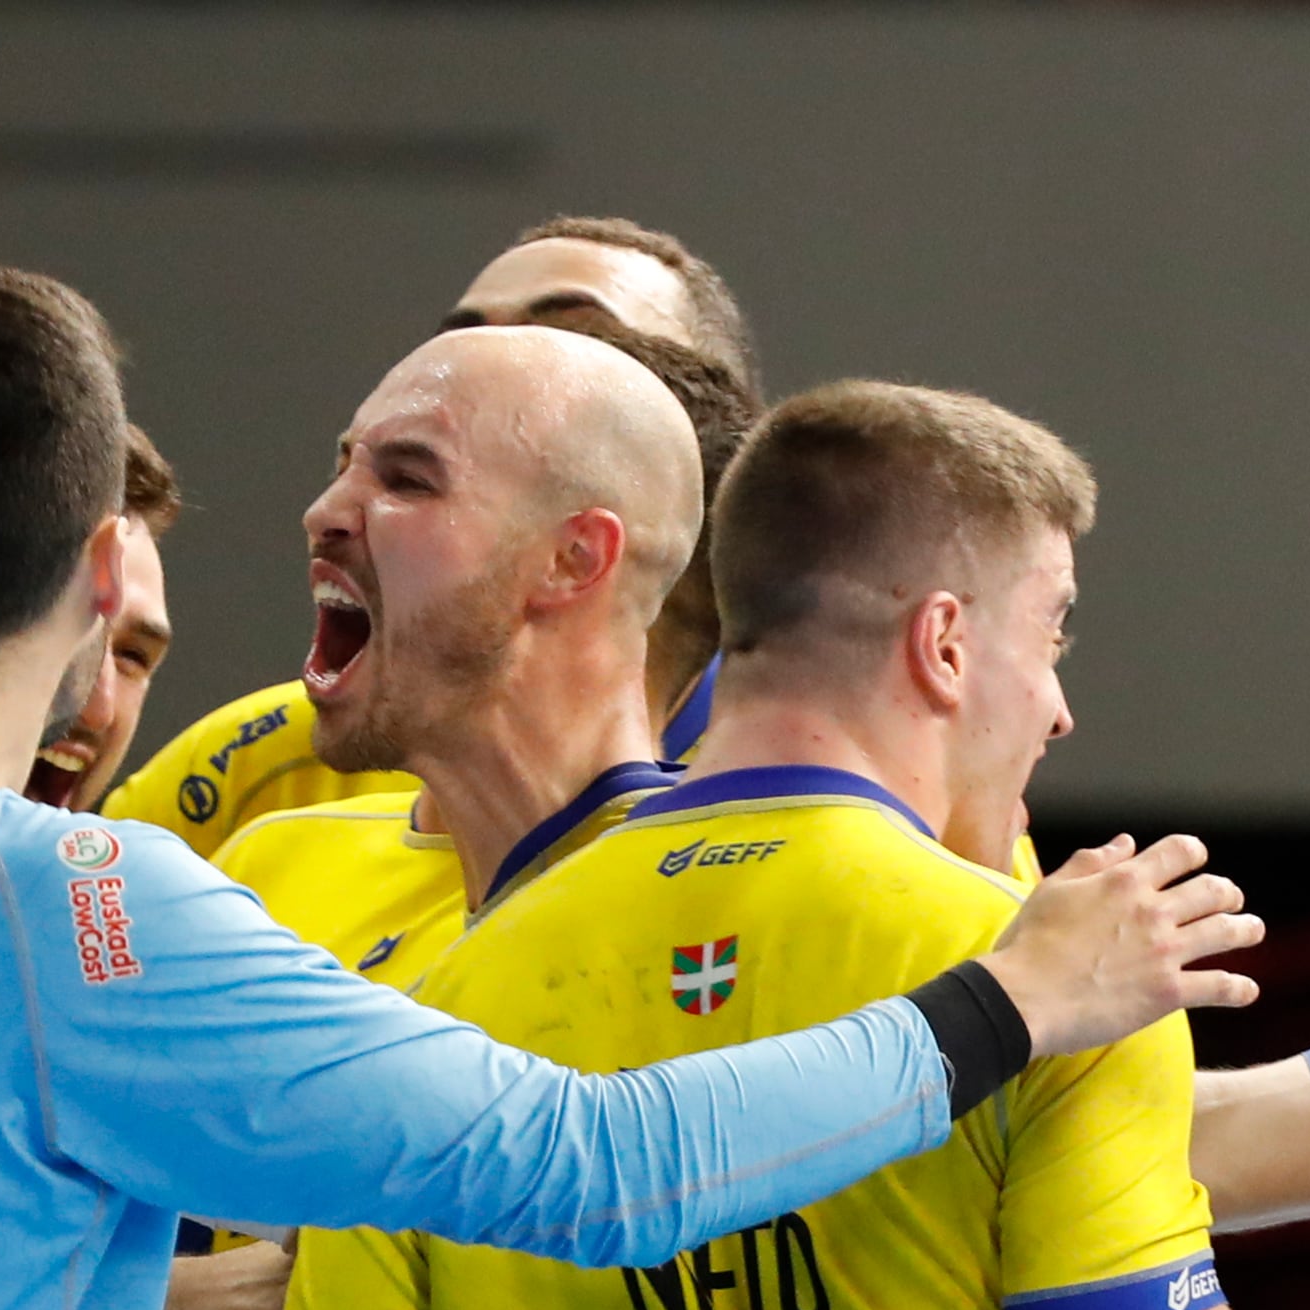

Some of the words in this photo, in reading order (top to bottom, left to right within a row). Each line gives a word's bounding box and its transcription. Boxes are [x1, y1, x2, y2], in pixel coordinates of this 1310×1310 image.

[696, 840, 787, 867] GEFF
[70, 880, 110, 982] LowCost
[98, 877, 140, 977] Euskadi
